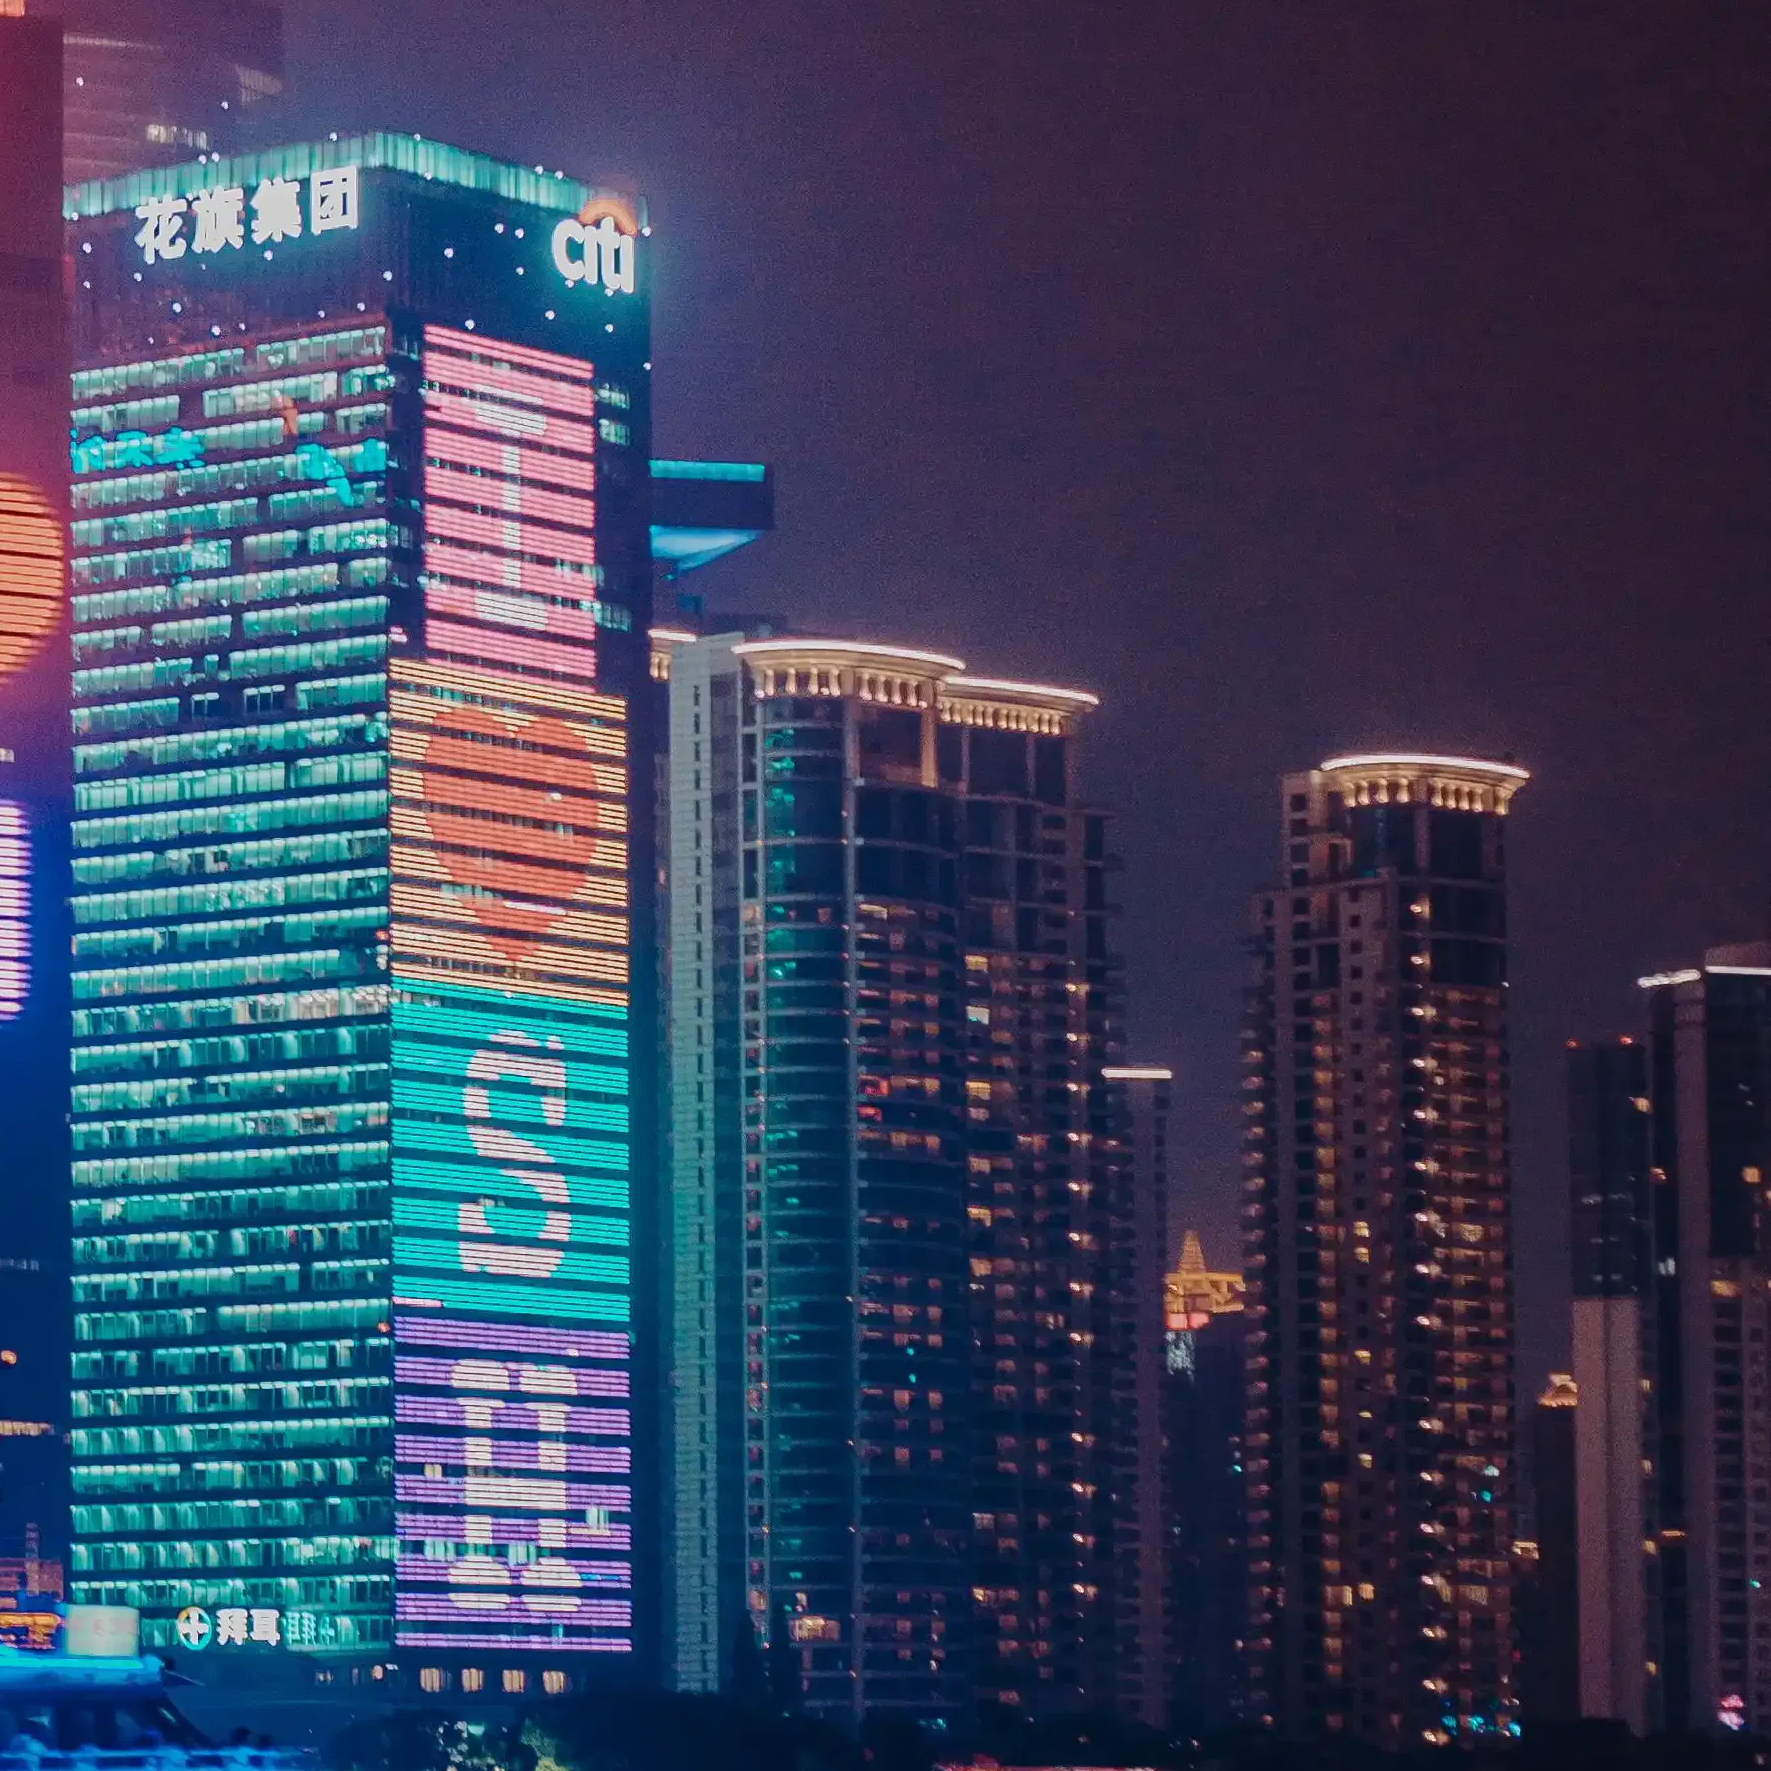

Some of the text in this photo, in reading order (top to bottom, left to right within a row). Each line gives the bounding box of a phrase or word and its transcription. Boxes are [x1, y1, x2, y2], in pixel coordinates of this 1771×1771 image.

[135, 164, 359, 263] 花旗集团
[216, 1607, 280, 1647] 拜耳
